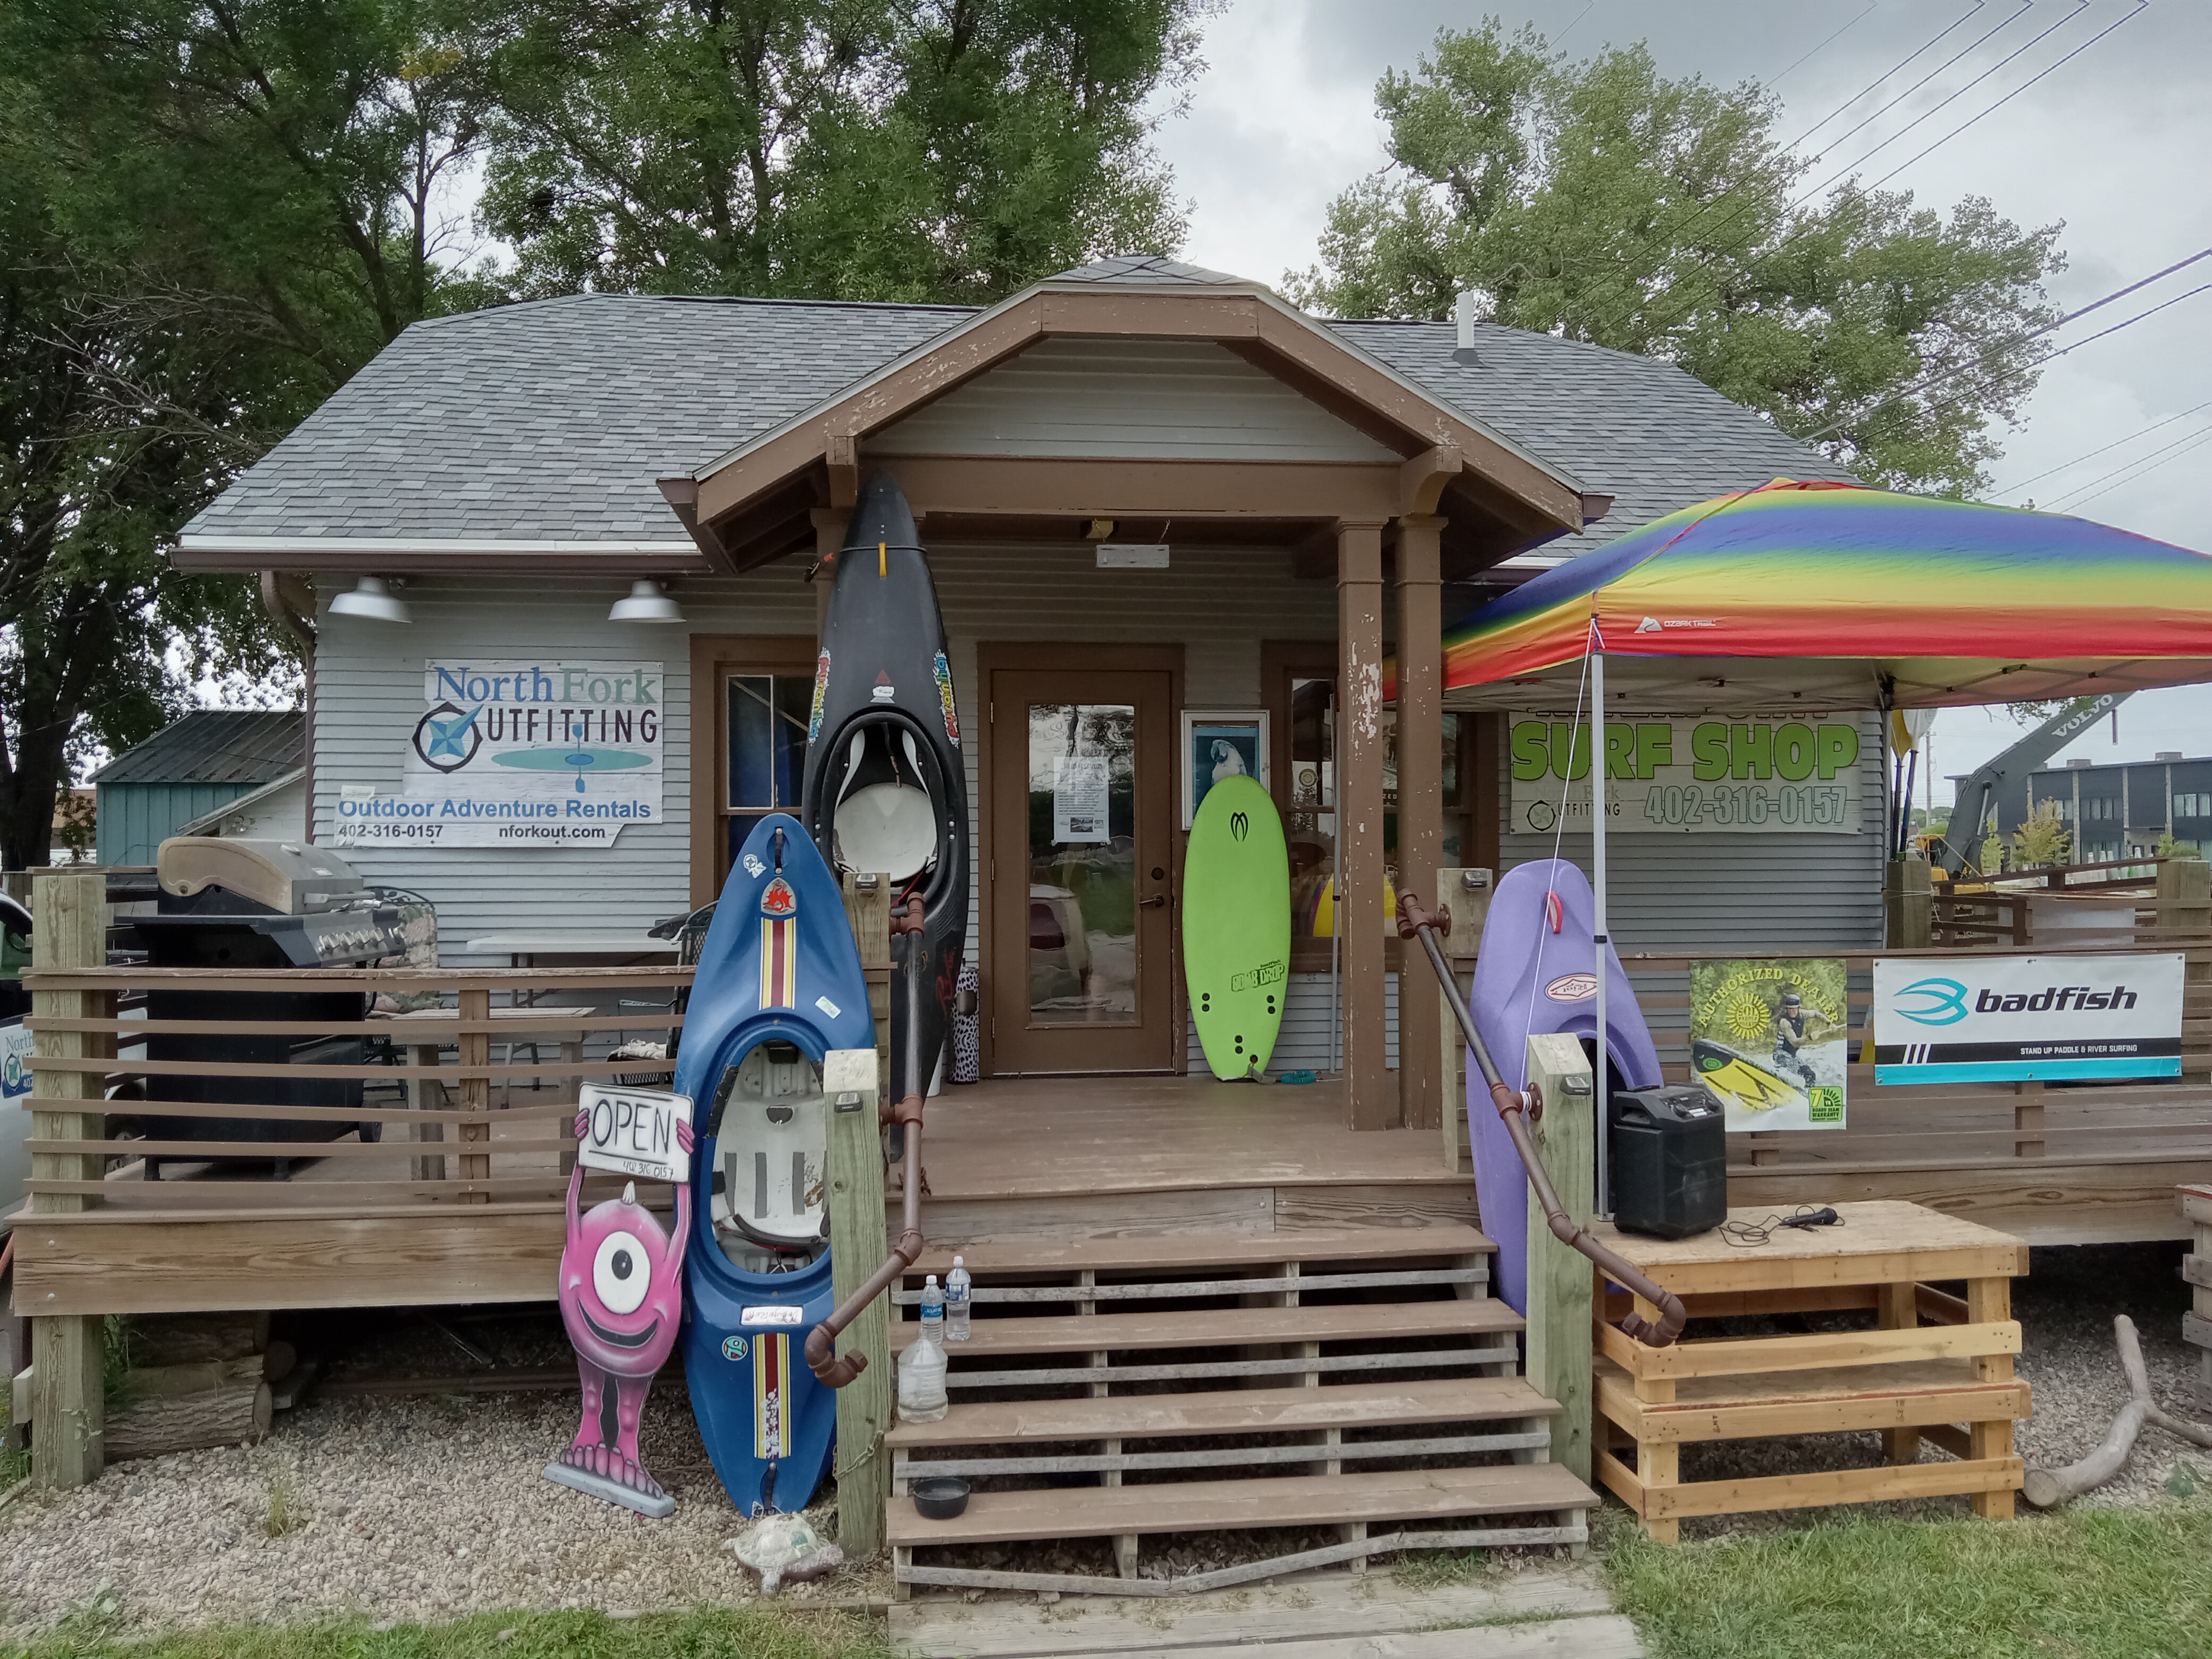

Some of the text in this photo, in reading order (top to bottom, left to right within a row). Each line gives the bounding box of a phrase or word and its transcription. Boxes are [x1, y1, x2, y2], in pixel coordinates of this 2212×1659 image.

[935, 657, 959, 739] pyranha
[2051, 694, 2113, 737] VOLVO
[1511, 720, 1858, 781] SURF SHOP
[1534, 785, 1620, 800] Norh Frk
[339, 799, 651, 818] Outdoor Adventure Rentals
[1644, 785, 1847, 824] 402-316-0157
[339, 825, 606, 839] 402-316-0157 nforkout.com
[1232, 964, 1284, 992] BOB DROP
[1563, 983, 1587, 992] Riot
[1699, 968, 1839, 1028] AUTHORIZED DEALER
[1975, 985, 2138, 1012] badfish
[1738, 1006, 1758, 1016] SOL
[6, 1031, 33, 1053] North
[2054, 1046, 2079, 1054] PADDLE
[2109, 1044, 2138, 1053] SURFING
[1810, 1088, 1823, 1108] 7
[592, 1099, 671, 1154] OPEN
[638, 1163, 651, 1175] 316
[653, 1167, 674, 1180] 0157
